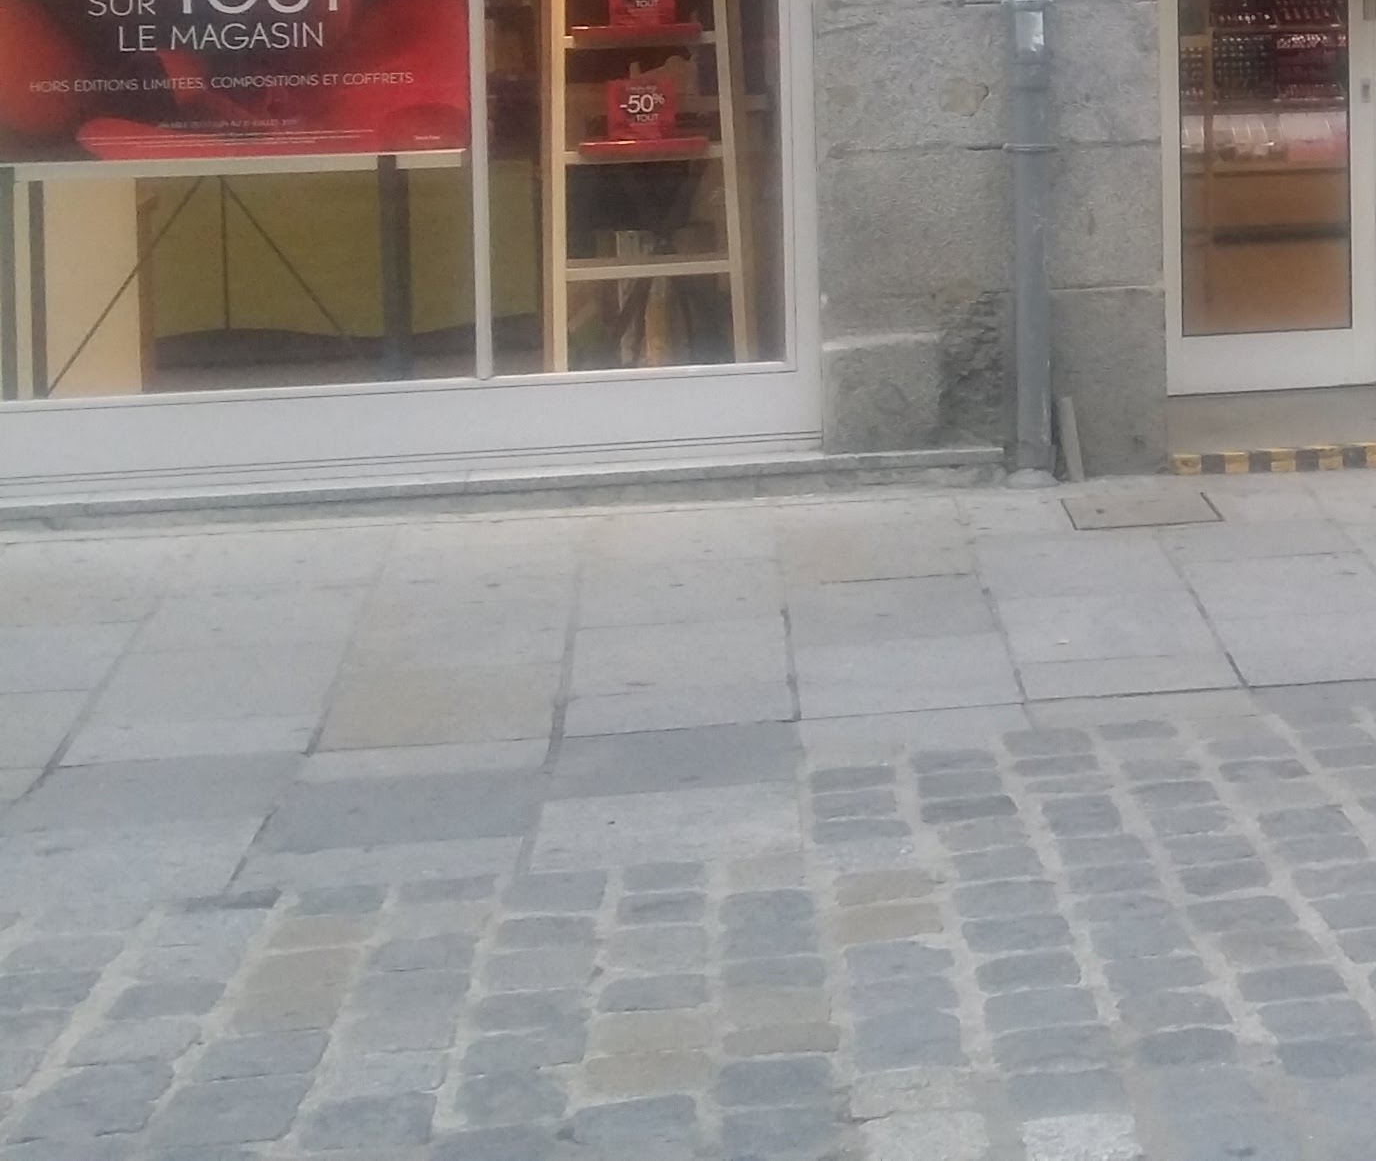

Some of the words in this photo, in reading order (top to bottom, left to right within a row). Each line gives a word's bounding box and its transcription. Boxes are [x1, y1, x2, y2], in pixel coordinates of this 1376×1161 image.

[635, 0, 659, 8] TOUT
[118, 25, 157, 52] LE
[170, 21, 324, 51] MAGASIN
[30, 80, 70, 93] HORS
[210, 75, 319, 89] COMPOSITIONS
[322, 74, 339, 86] ET
[343, 72, 414, 86] COFFRETS
[619, 94, 665, 114] -50%
